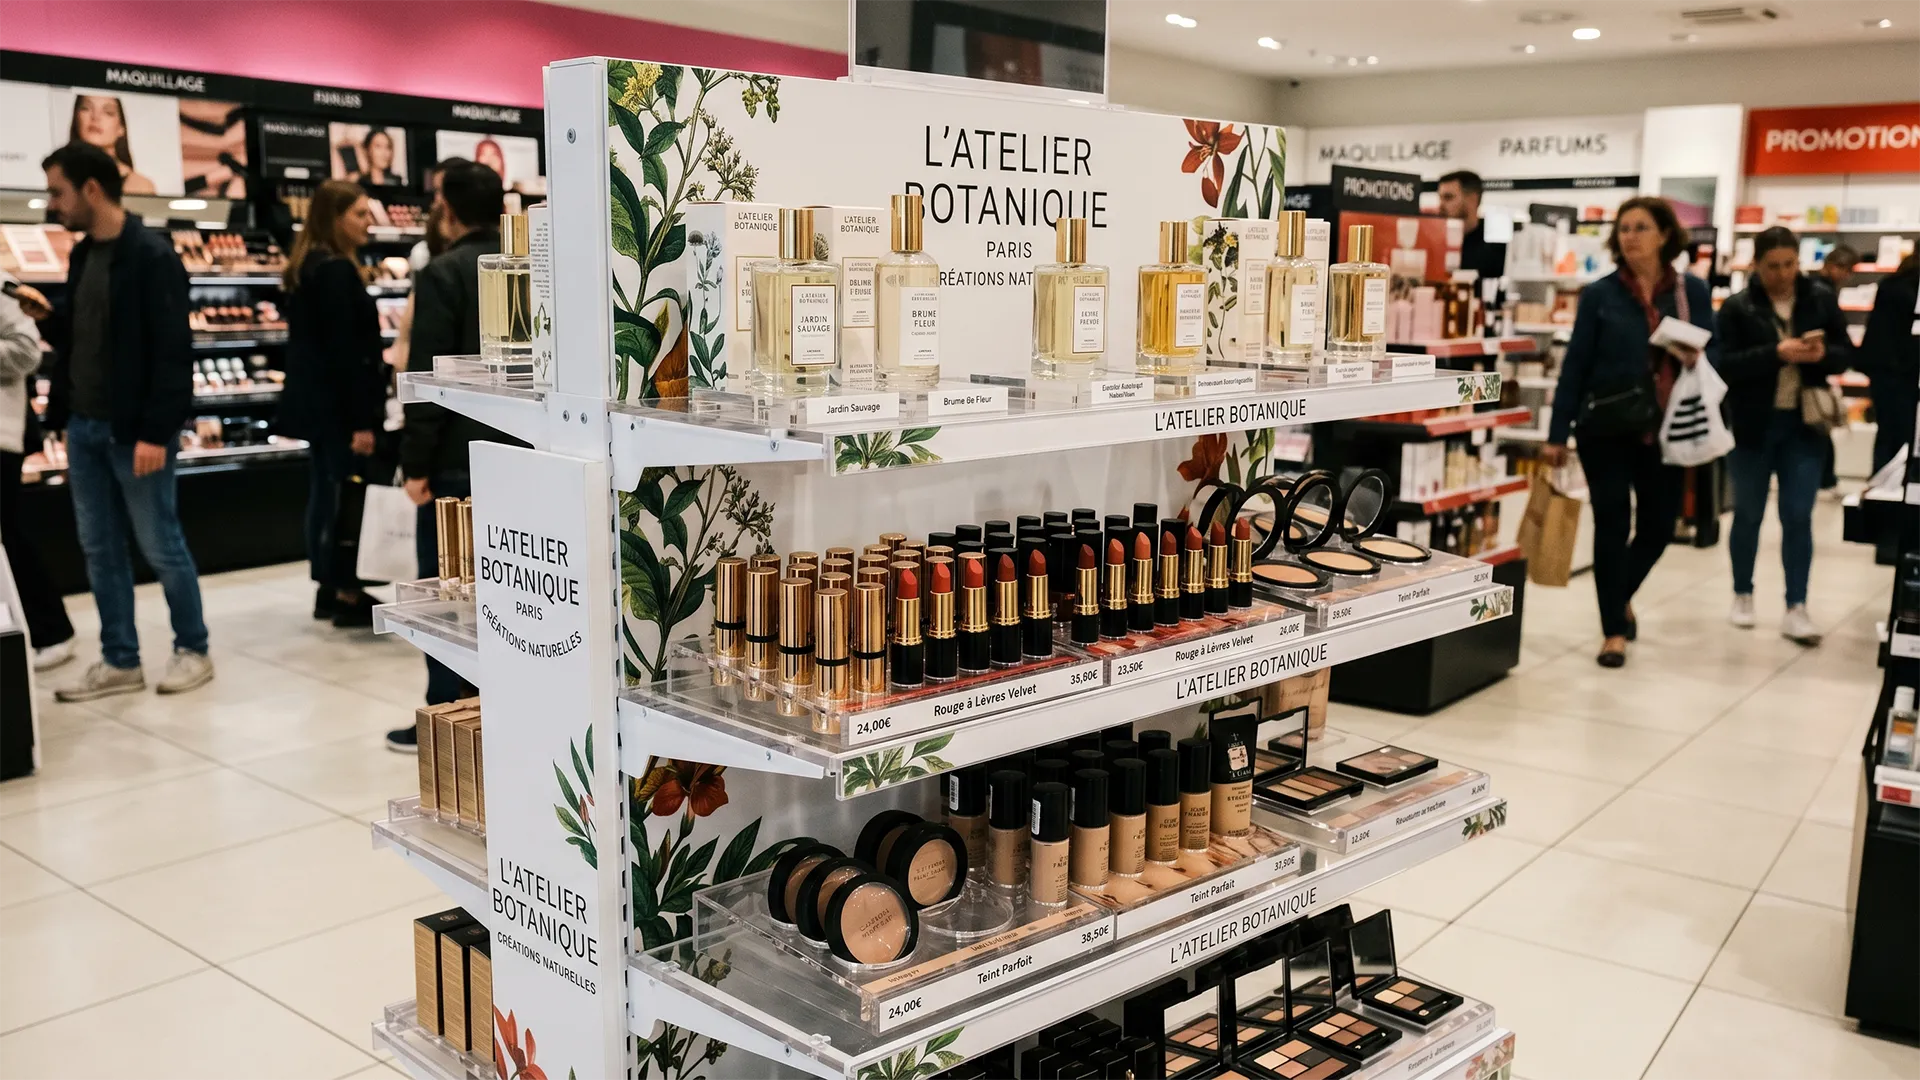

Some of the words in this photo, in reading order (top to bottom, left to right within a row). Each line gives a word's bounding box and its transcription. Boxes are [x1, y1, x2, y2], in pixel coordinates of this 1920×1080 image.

[924, 125, 1092, 177] L'ATELIER
[1318, 139, 1453, 162] MAQUILLAGE
[1498, 133, 1609, 157] PARFUMS
[734, 221, 778, 232] BOTANIQUE
[737, 211, 774, 222] L'ATELIER
[840, 224, 880, 234] BOTANIQUE
[986, 241, 1033, 261] PARIS
[939, 267, 1005, 287] RÉATIONS
[800, 315, 828, 323] JARDIN
[911, 310, 937, 319] BRUME
[914, 319, 936, 328] FLEUR
[797, 324, 831, 333] SAUVAGE
[826, 404, 850, 414] Jardin
[851, 402, 881, 414] Sauvage
[943, 397, 965, 406] Brume
[975, 395, 993, 405] Fleur
[1155, 408, 1226, 433] L'ATELIER
[1229, 399, 1307, 426] BOTANIQUE
[486, 524, 569, 568] L'ATELIER
[481, 555, 580, 607] BOTANIQUE
[515, 601, 543, 621] PARIS
[481, 603, 527, 654] CRÉATIONS
[528, 630, 583, 659] NATURELLES
[1175, 647, 1200, 662] Rouge
[1206, 639, 1231, 655] Lèvres
[1231, 633, 1254, 649] Velvet
[1117, 659, 1144, 676] 23,50€
[1176, 665, 1247, 700] L'ATELIER
[1249, 643, 1329, 681] BOTANIQUE
[933, 699, 964, 718] Rouge
[975, 690, 1006, 707] Lèvres
[1007, 682, 1037, 701] Velvet
[857, 716, 892, 735] 24,00€
[499, 857, 588, 925] L'ATELIER
[1190, 887, 1210, 904] Teint
[1211, 878, 1236, 898] Parfait
[492, 887, 599, 967] BOTANIQUE
[1081, 924, 1110, 944] 38,50€
[1170, 920, 1238, 965] L'ATELIER
[1241, 886, 1318, 933] BOTANIQUE
[497, 931, 541, 965] CRÉATIONS
[542, 956, 597, 996] NATURELLES
[976, 968, 1000, 985] Teint
[888, 996, 922, 1019] 24,00€
